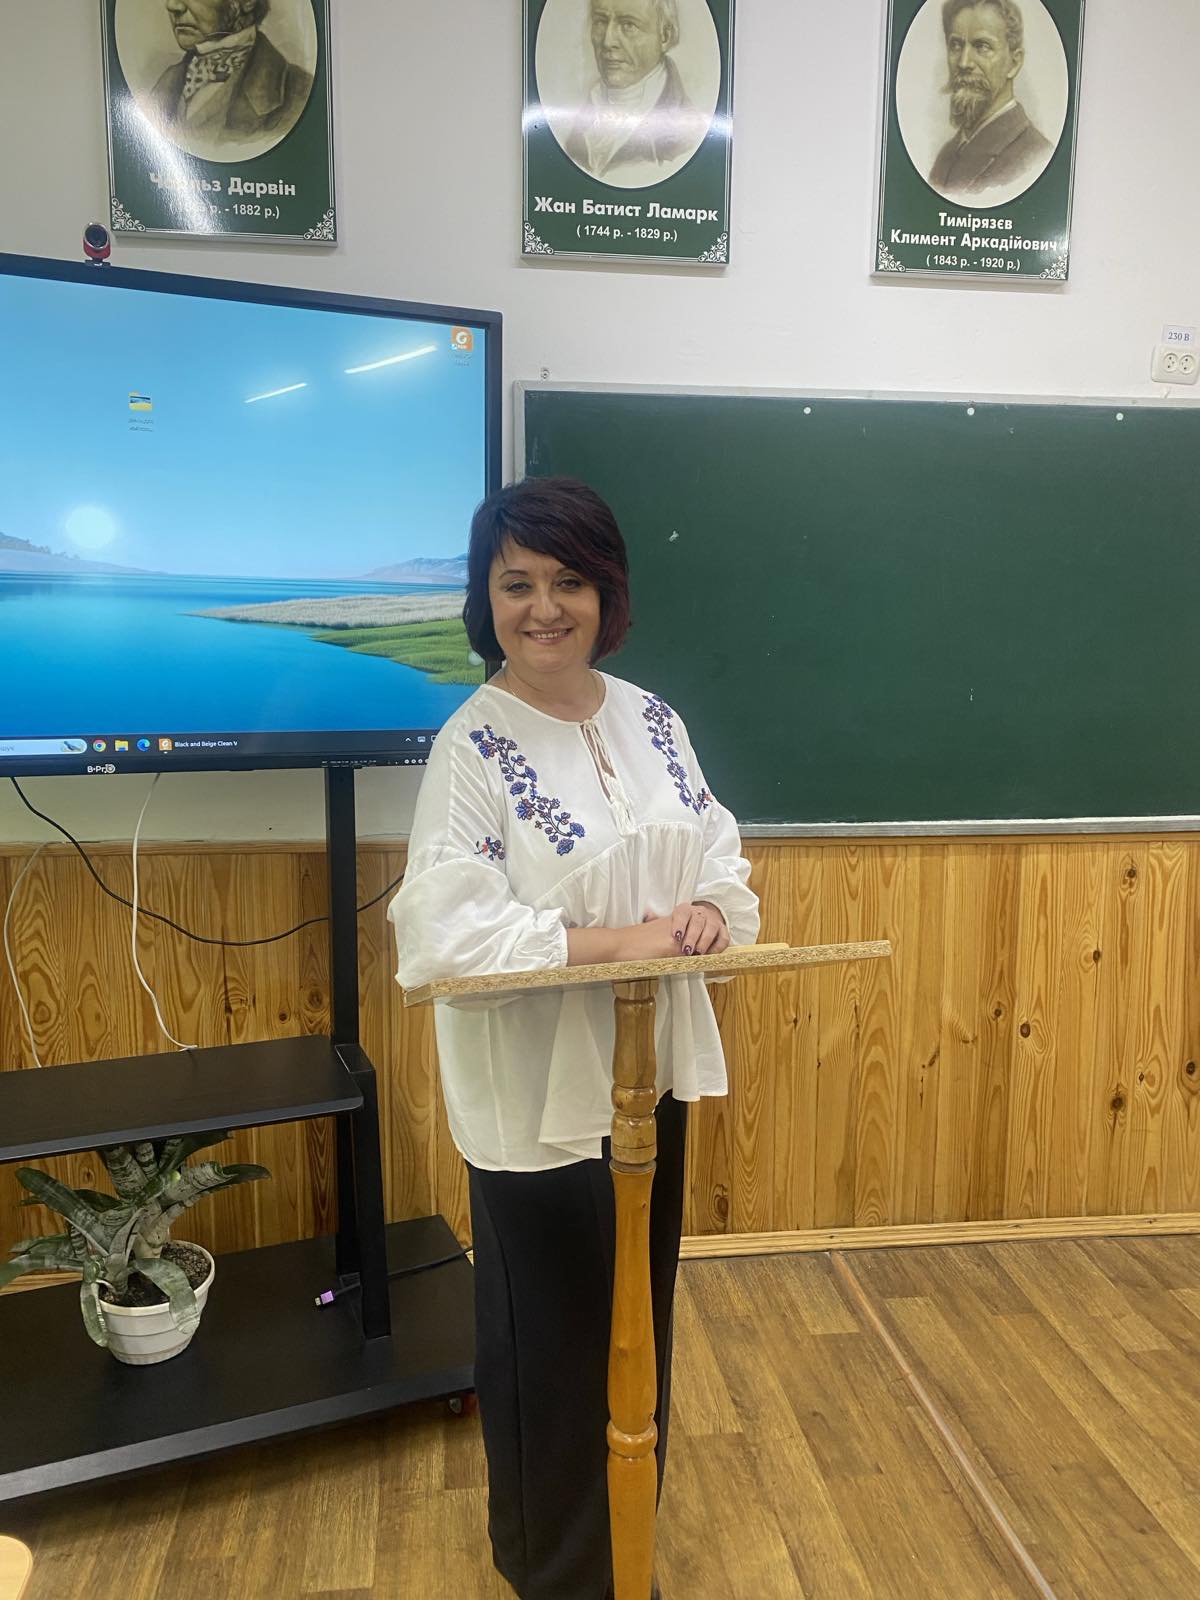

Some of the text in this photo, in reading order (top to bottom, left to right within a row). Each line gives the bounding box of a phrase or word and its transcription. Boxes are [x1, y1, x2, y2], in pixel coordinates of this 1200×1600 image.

[228, 177, 296, 198] Дарвін
[233, 204, 261, 216] 1882
[264, 205, 280, 220] р.)
[534, 196, 718, 224] Жан Батист Ламарк
[938, 212, 1013, 232] Тимірязєв
[613, 228, 624, 240] р.
[634, 228, 661, 239] 1829
[663, 229, 678, 243] р.)
[890, 229, 1057, 252] Климент Аркадійович
[960, 258, 970, 269] р.
[980, 257, 1004, 268] 1920
[1168, 332, 1182, 341] 230
